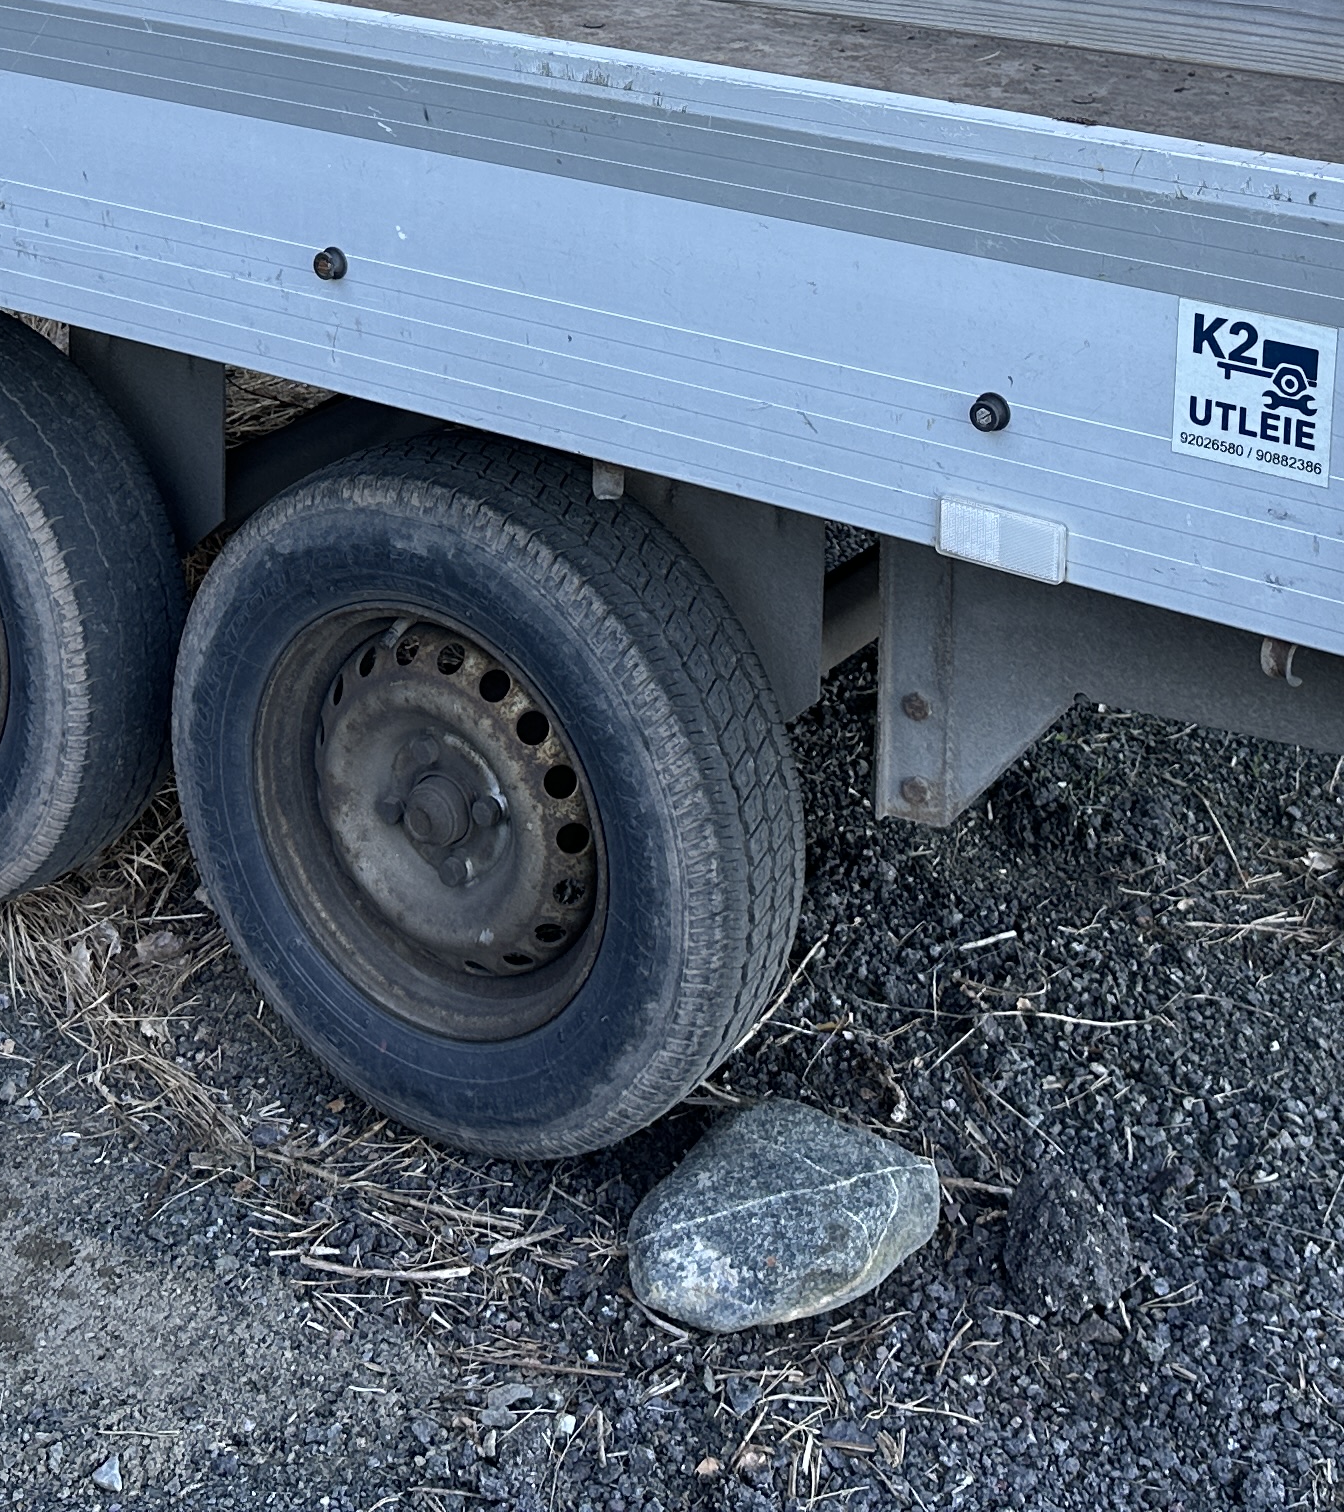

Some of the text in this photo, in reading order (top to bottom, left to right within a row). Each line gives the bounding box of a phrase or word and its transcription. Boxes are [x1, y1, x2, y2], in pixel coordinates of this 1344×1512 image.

[1192, 312, 1259, 366] K2
[1189, 395, 1316, 451] UTLEIE
[1180, 431, 1244, 457] 92026580
[1256, 449, 1323, 475] 90882386
